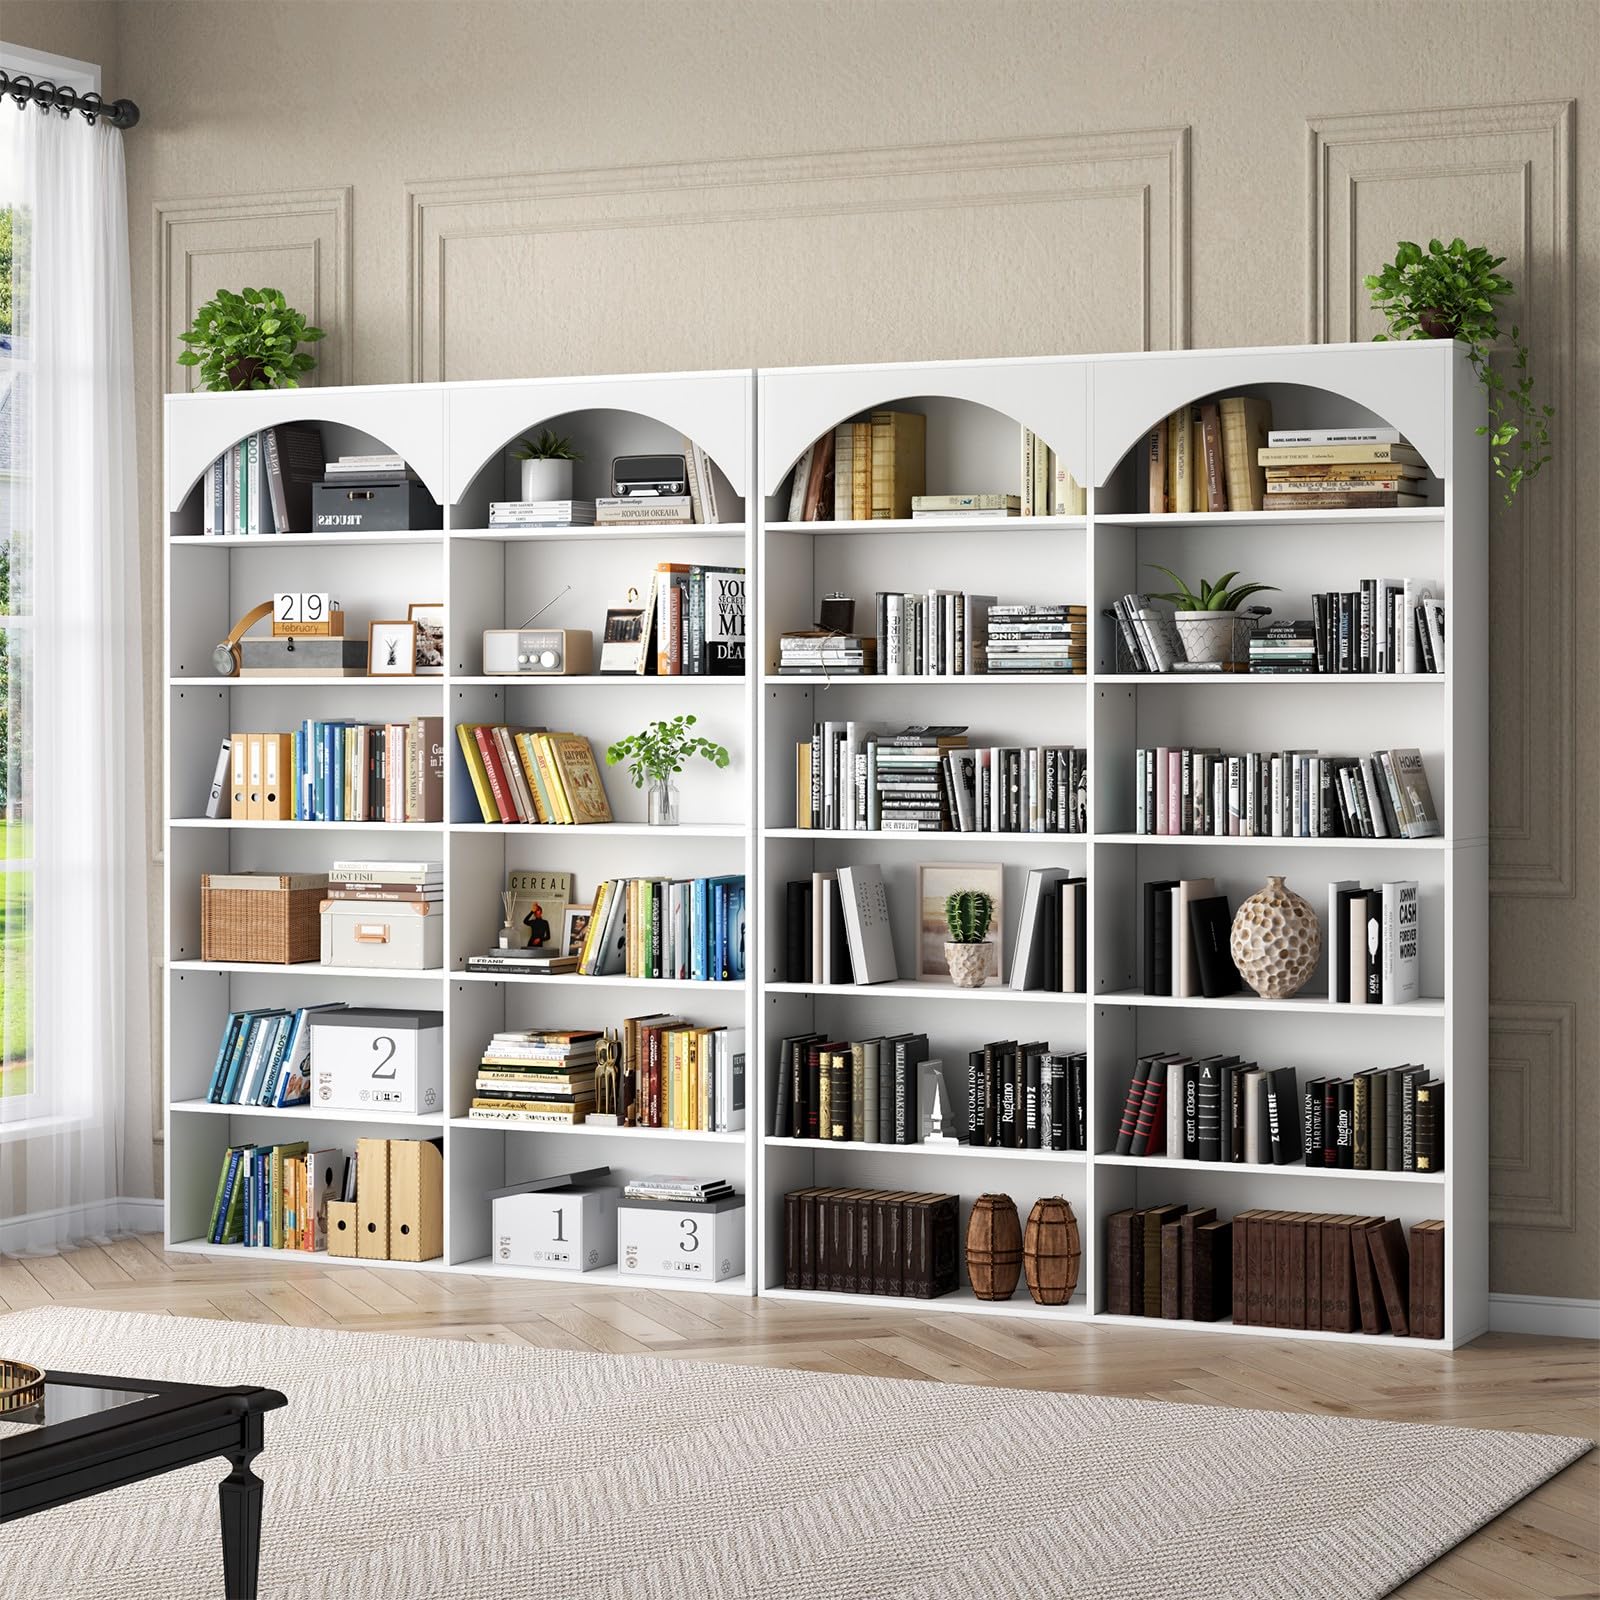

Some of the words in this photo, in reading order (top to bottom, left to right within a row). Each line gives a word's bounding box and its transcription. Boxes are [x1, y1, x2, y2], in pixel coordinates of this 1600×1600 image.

[1151, 433, 1159, 463] THRIFT
[621, 509, 649, 518] КОРОЛИ
[650, 508, 679, 517] ОКЕАНА
[281, 595, 294, 620] 2
[307, 594, 321, 620] 9
[718, 595, 745, 604] SECRET
[281, 623, 319, 634] february
[1341, 611, 1349, 638] FINANCE
[717, 645, 745, 659] DEA
[1341, 638, 1349, 658] WATER
[508, 750, 518, 766] ART
[537, 755, 546, 769] ART
[1046, 751, 1055, 766] The
[1230, 761, 1238, 777] Book
[1399, 756, 1421, 769] HOME
[519, 746, 530, 771] FINE
[528, 774, 543, 812] WINES
[1046, 767, 1055, 800] Outsider
[1230, 778, 1238, 789] The
[331, 872, 354, 881] LOST
[354, 873, 373, 881] FISH
[511, 877, 565, 890] CEREAL
[1399, 887, 1417, 903] JOHNNY
[1399, 903, 1417, 925] CASH
[1399, 928, 1417, 943] FOREVER
[1399, 942, 1417, 960] WORDS
[245, 1022, 260, 1058] WINDOWS
[265, 1057, 280, 1093] WORKING
[275, 1033, 287, 1057] DAD'S
[372, 1036, 396, 1080] 2
[895, 1044, 905, 1083] WILLIAM
[1202, 1067, 1211, 1078] A
[968, 1065, 976, 1131] RESTORATION
[977, 1071, 985, 1126] HARDWARE
[1002, 1082, 1015, 1123] Rugiano
[1186, 1080, 1195, 1116] deco
[1403, 1075, 1413, 1112] WILLIAM
[895, 1084, 905, 1143] SHAKESPEARE
[1026, 1094, 1036, 1130] GALLERIE
[1267, 1092, 1279, 1134] GALLERIE
[1313, 1099, 1322, 1149] HARDWARE
[1186, 1119, 1195, 1142] art
[1337, 1109, 1352, 1146] Rugiano
[1403, 1113, 1413, 1169] SHAKESPEARE
[552, 1208, 569, 1242] 1
[679, 1218, 700, 1252] 3
